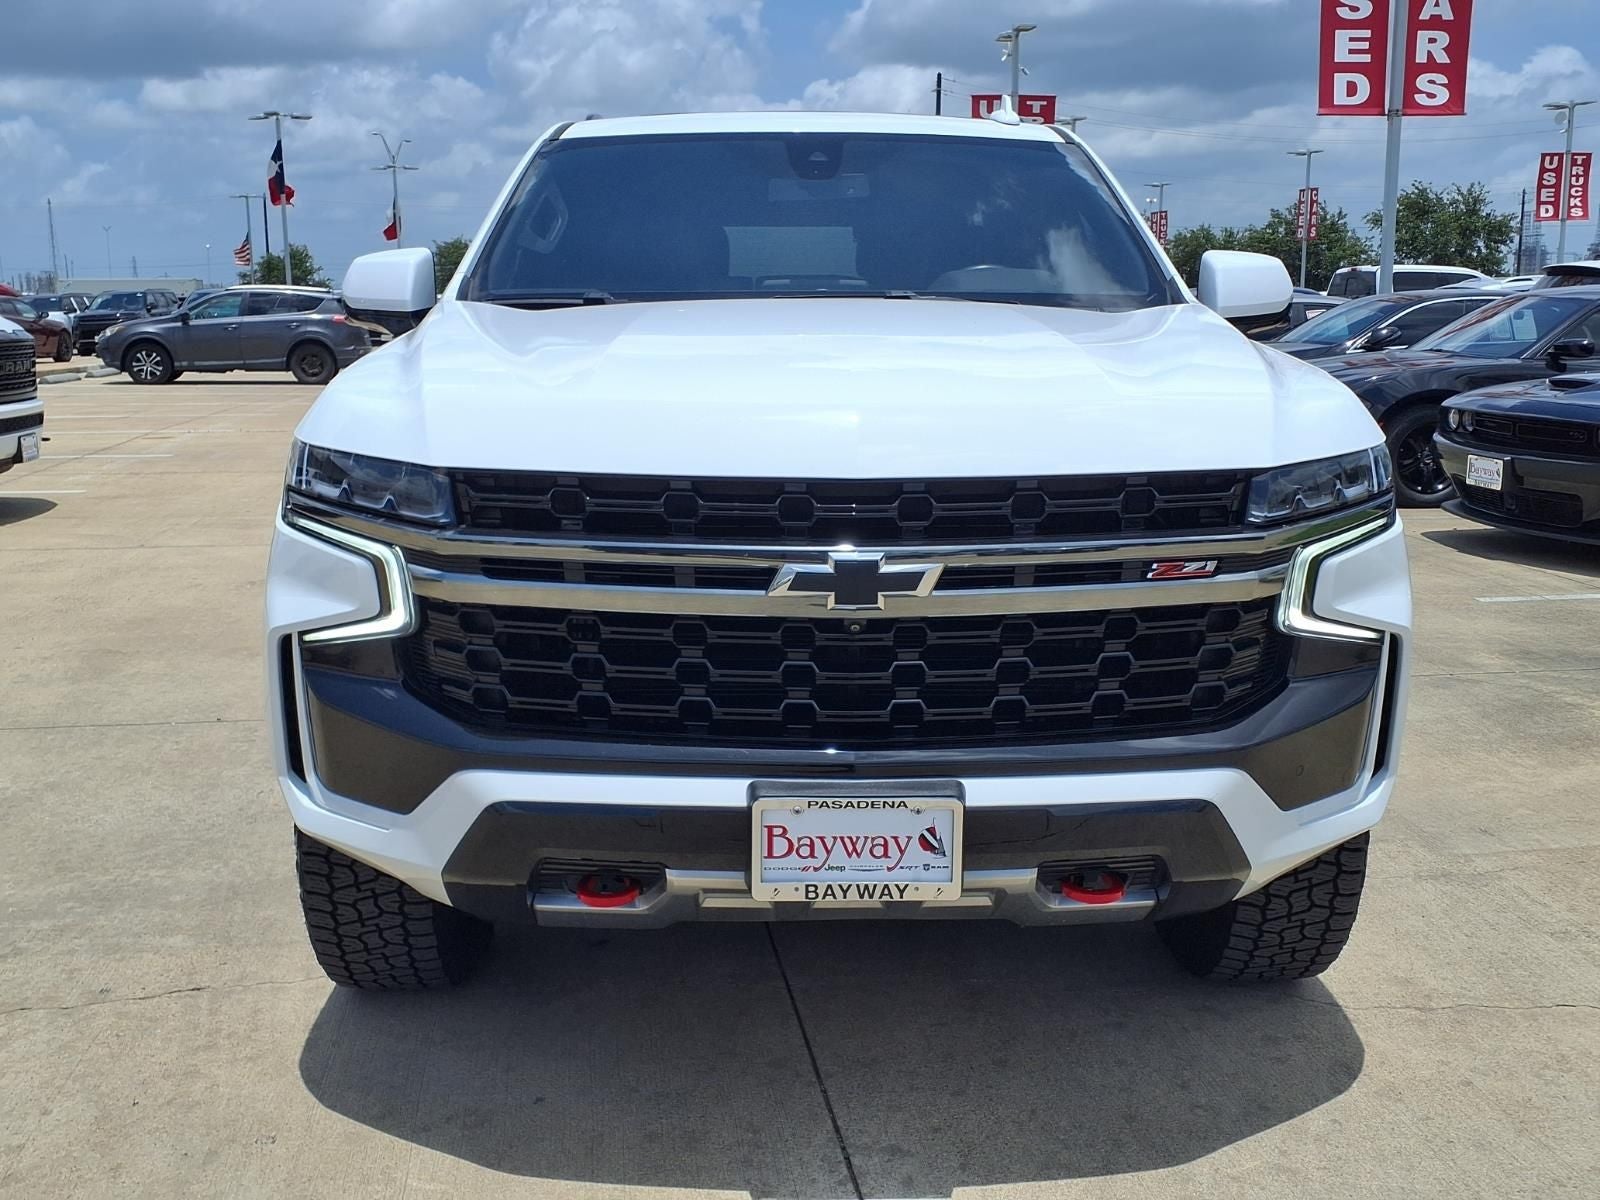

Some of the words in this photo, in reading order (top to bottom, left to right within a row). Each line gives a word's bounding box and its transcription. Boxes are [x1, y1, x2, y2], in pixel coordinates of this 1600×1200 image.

[1540, 156, 1559, 217] USED
[1569, 155, 1587, 217] TRUCKS
[1297, 191, 1305, 238] USED
[1310, 190, 1318, 237] CARS
[1146, 560, 1218, 579] Z71
[807, 800, 909, 809] PASADENA
[763, 825, 913, 872] Bayway
[824, 864, 846, 872] Jeep
[804, 883, 909, 900] BAYWAY
